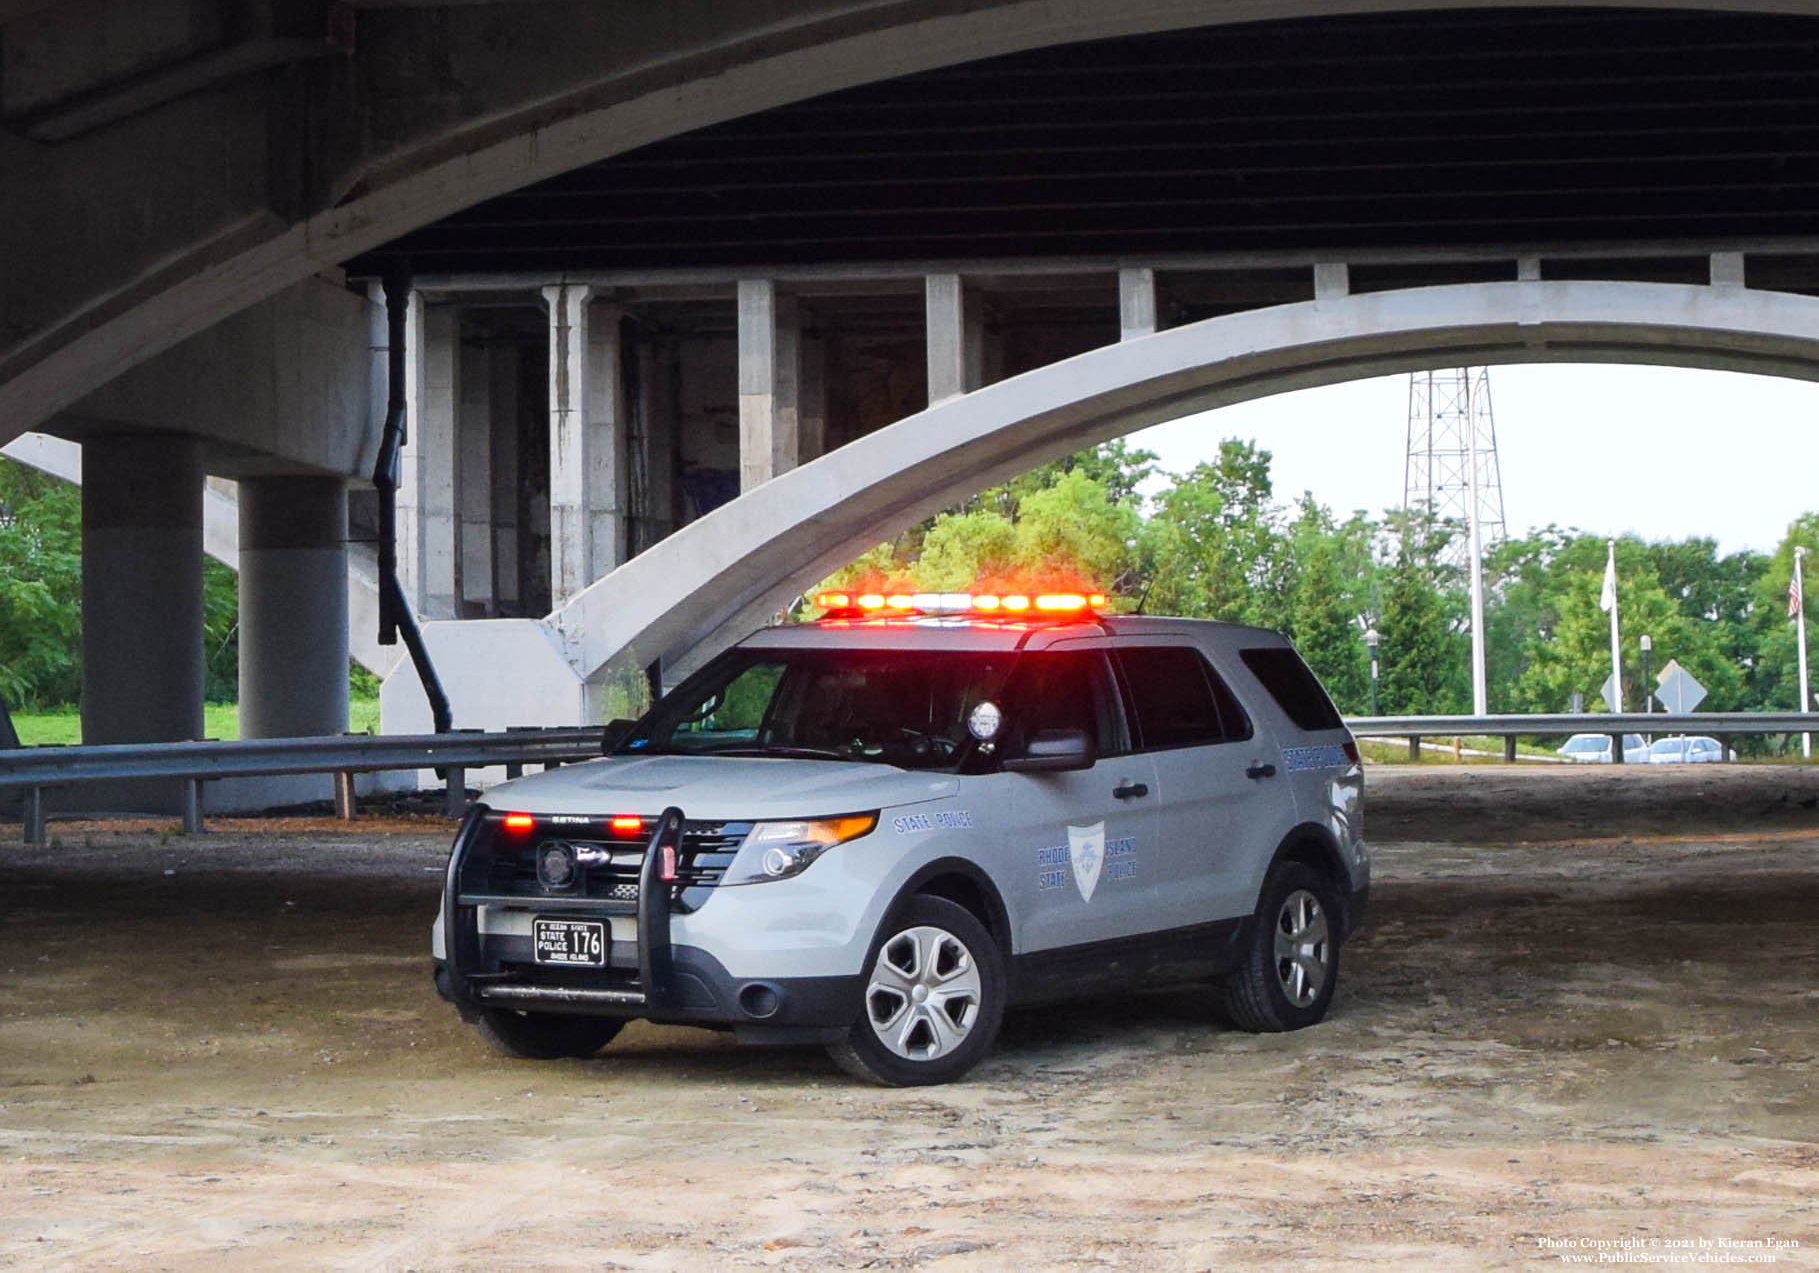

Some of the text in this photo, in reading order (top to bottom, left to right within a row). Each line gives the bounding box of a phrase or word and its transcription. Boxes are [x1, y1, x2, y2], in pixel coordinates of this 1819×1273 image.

[893, 810, 973, 834] STATE POLICE
[1038, 845, 1071, 867] RHODE
[1039, 870, 1065, 892] STATE
[538, 940, 568, 952] POLICE
[540, 931, 565, 942] STATE
[573, 931, 601, 955] 176
